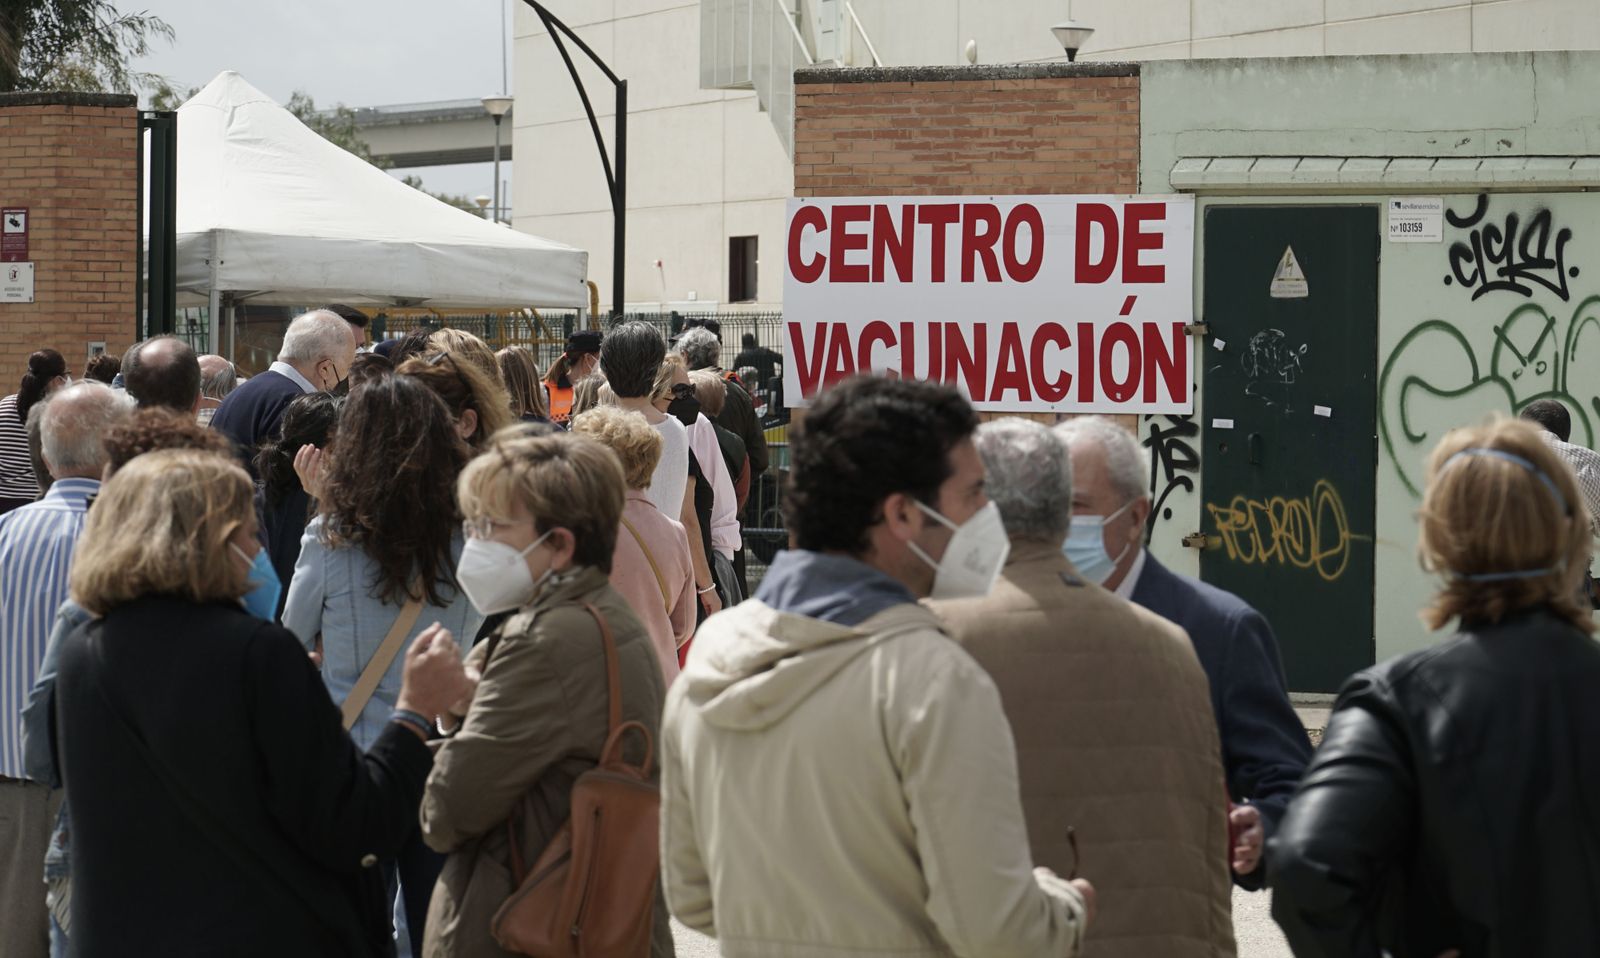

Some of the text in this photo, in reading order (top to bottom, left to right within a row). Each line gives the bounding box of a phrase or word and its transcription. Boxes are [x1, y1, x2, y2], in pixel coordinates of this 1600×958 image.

[787, 202, 1167, 284] CENTRO DE
[1399, 222, 1423, 233] 103159
[787, 295, 1187, 404] VACUNACIÓN
